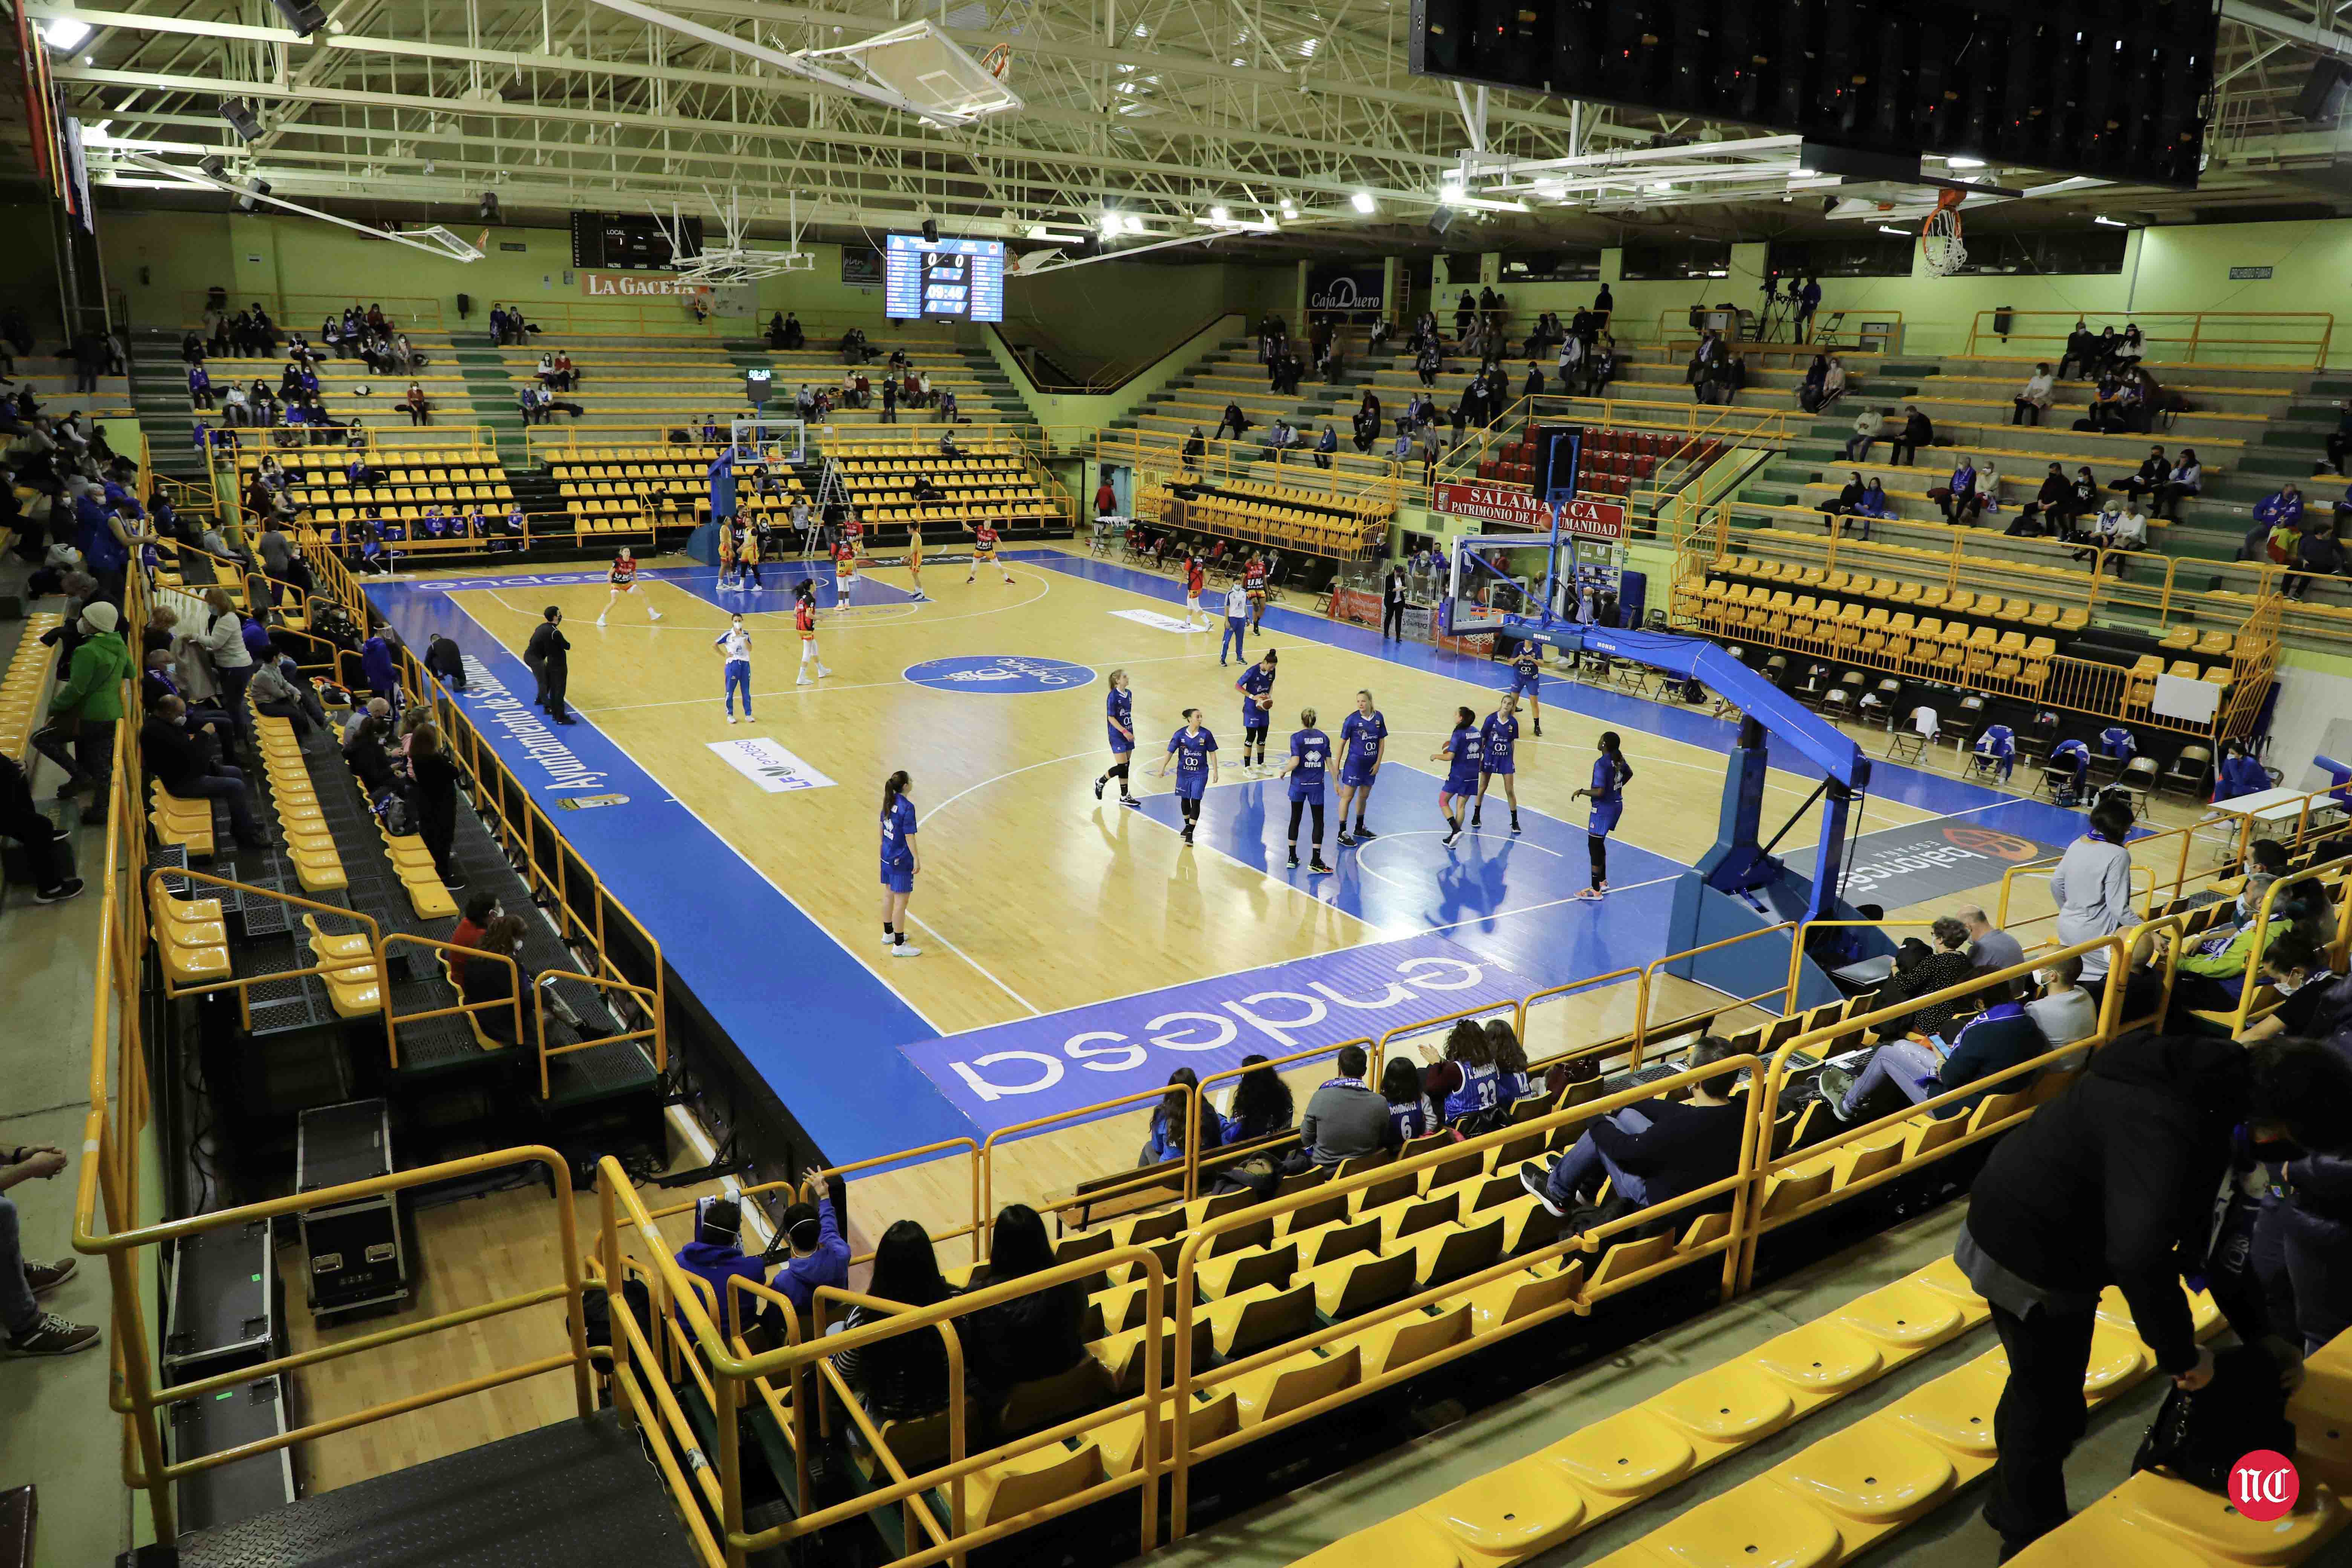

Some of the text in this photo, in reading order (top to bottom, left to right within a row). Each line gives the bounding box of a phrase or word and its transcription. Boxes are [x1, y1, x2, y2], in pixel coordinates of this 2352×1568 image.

[955, 254, 964, 267] 0
[588, 275, 617, 295] LA
[1312, 277, 1380, 309] Caja Duero
[1451, 501, 1513, 521] PATRIMONIO
[1515, 511, 1530, 524] DE
[1557, 518, 1617, 536] UMANIDAD
[1533, 633, 1551, 641] MONDO
[1597, 642, 1616, 651] MONDO
[474, 697, 524, 709] de
[490, 710, 608, 790] Ayuntamiento
[735, 741, 813, 788] LF endesa
[1870, 840, 1941, 858] ESPAÑA
[949, 957, 1484, 1102] endesa
[1478, 1079, 1497, 1110] 33
[1401, 1115, 1412, 1140] 6
